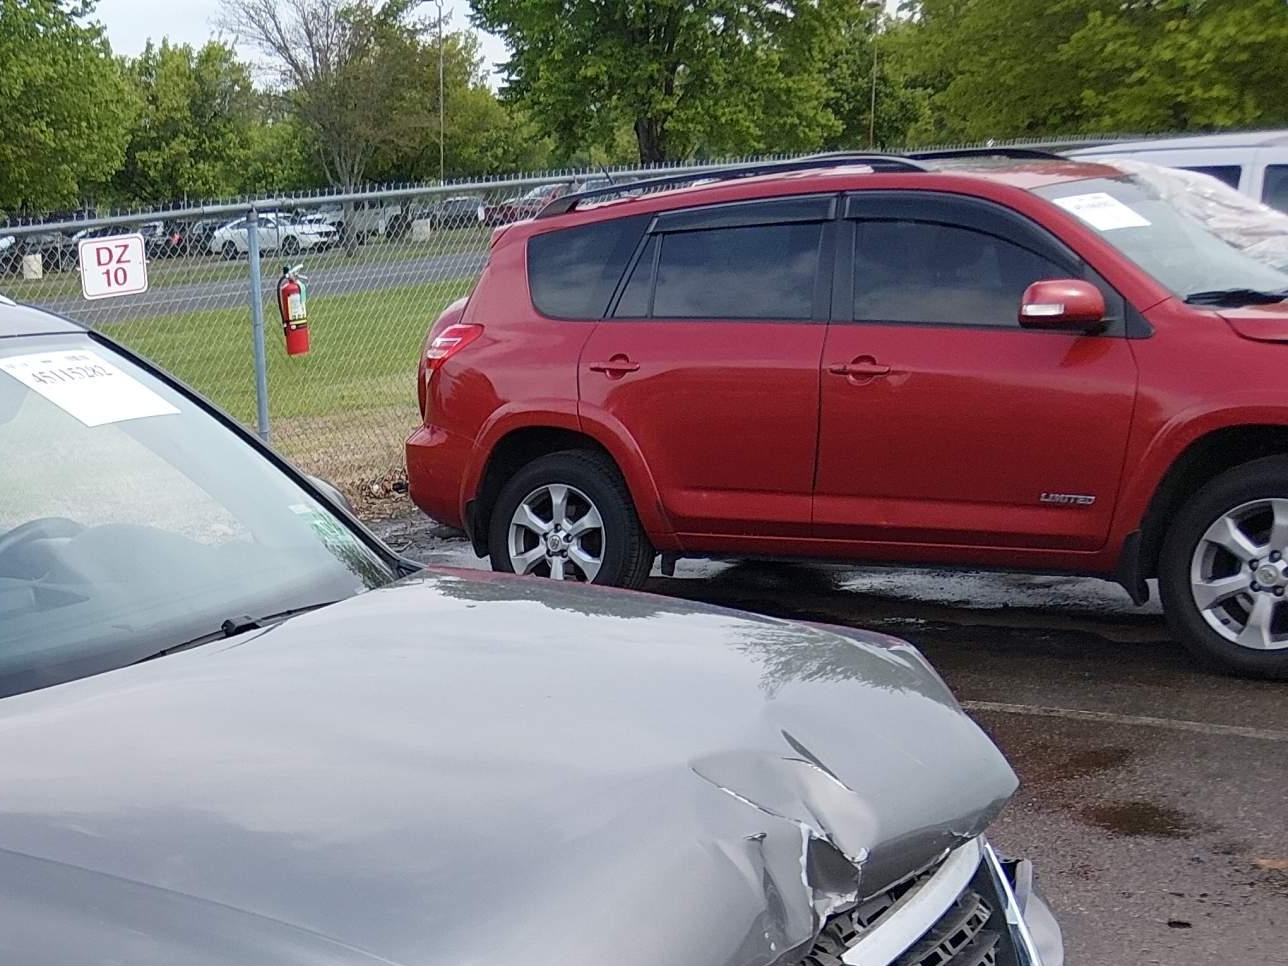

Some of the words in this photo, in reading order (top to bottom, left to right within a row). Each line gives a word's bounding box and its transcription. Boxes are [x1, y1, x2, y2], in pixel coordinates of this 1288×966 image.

[96, 244, 131, 266] DZ
[102, 267, 128, 287] 10
[31, 364, 113, 384] 45115282
[1039, 492, 1096, 505] LIMITED
